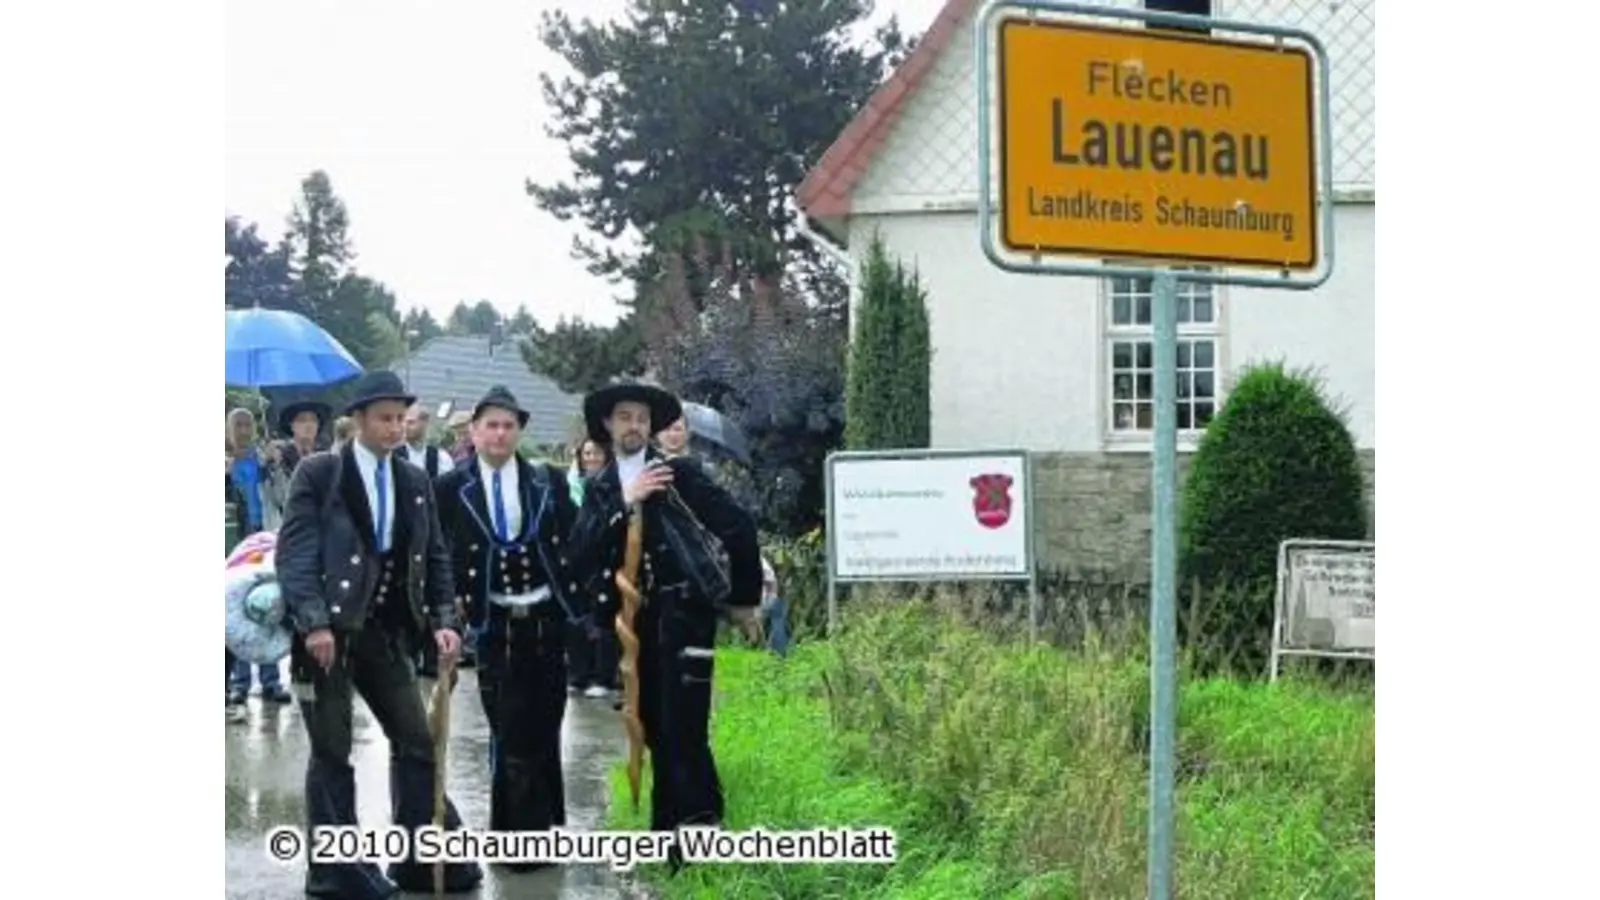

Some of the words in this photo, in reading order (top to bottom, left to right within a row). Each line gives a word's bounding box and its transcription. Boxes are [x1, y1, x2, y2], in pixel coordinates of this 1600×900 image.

[1087, 60, 1232, 108] Flecken
[1051, 97, 1269, 180] Lauenau
[1027, 186, 1143, 224] Landkreis
[1156, 195, 1294, 241] Schaumburg
